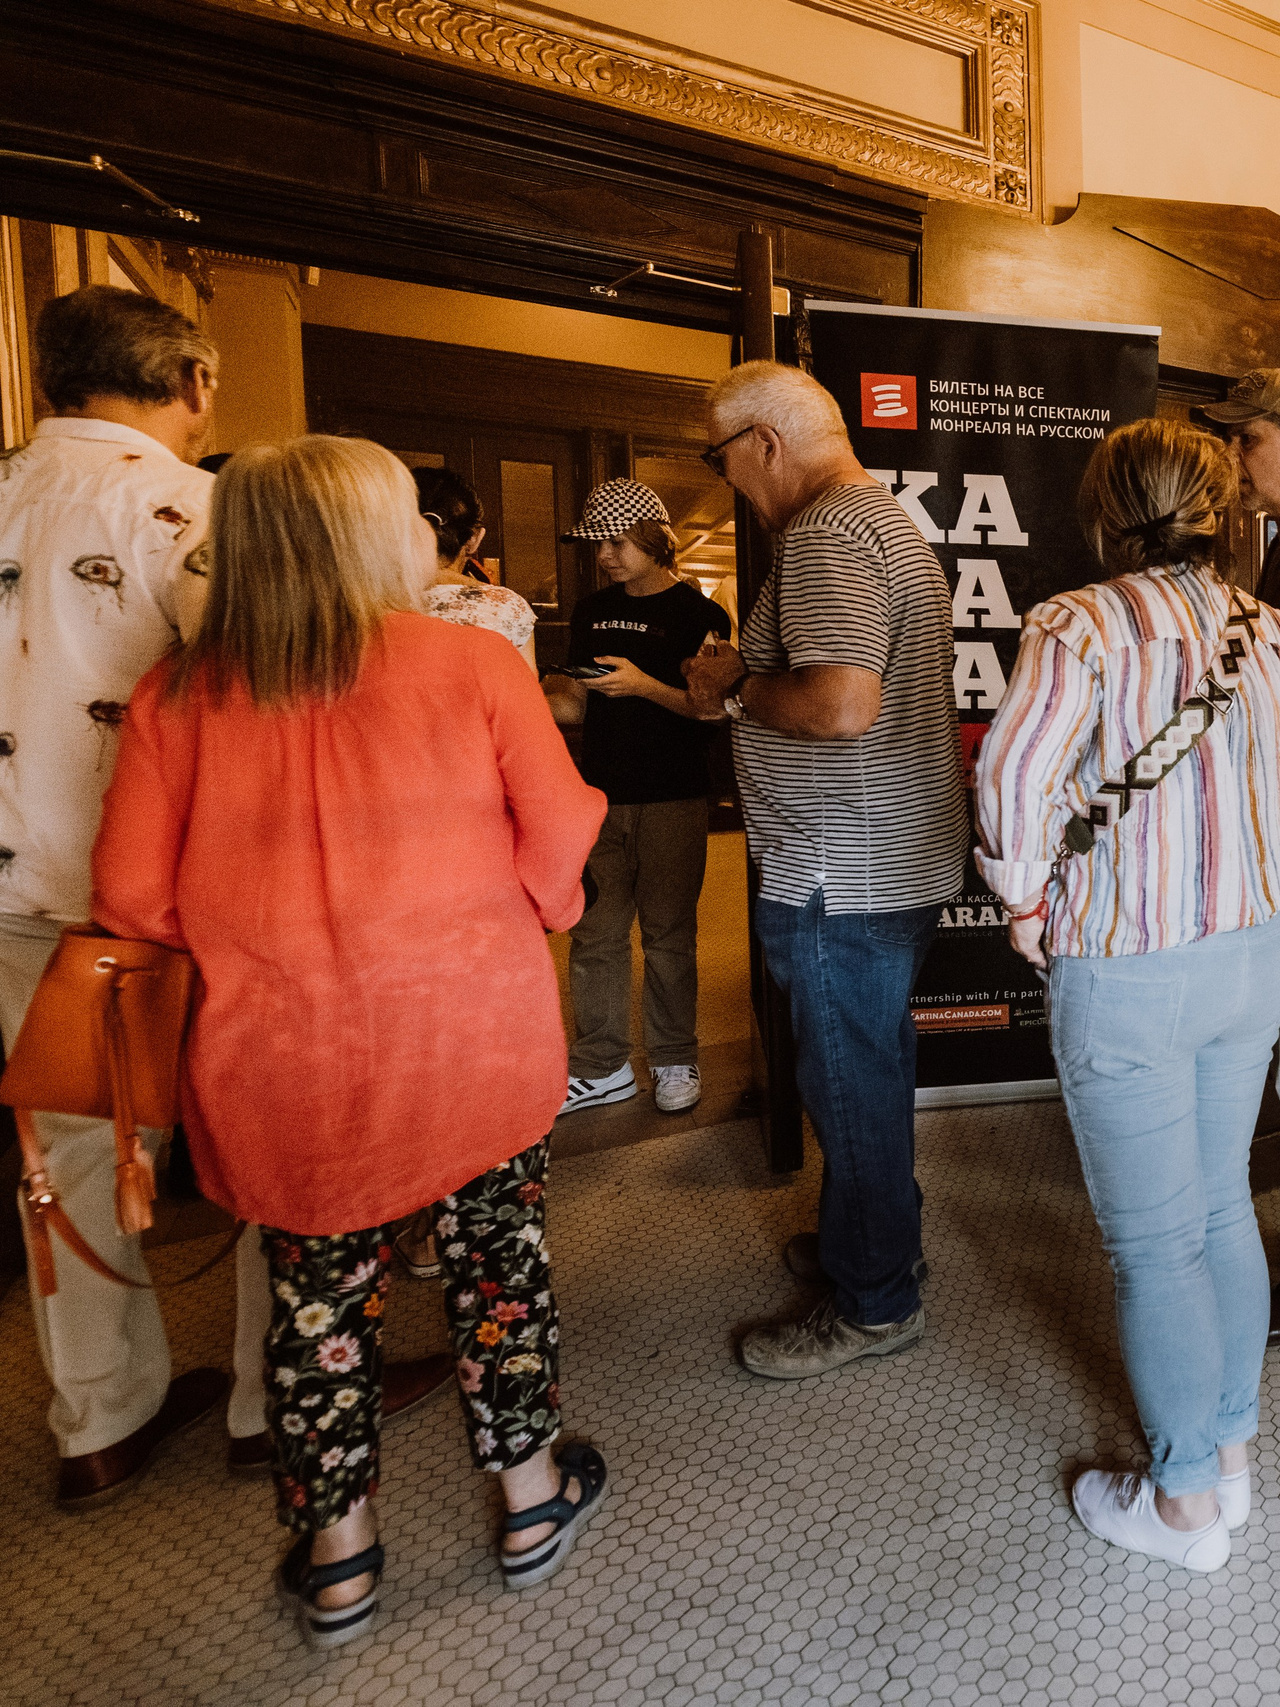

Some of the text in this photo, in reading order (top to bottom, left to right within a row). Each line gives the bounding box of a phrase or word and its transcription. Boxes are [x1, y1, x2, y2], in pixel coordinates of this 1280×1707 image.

[929, 379, 1045, 400] БИЛЕТЫ НА ВСЕ
[930, 399, 1110, 422] КОНЦЕРТЫ И СПЕКТАКЛИ
[930, 418, 1105, 440] МОНРЕАЛЯ НА РУССКОМ
[953, 558, 1022, 629] A
[953, 641, 1008, 710] A
[949, 894, 1001, 904] АЯ КАССА
[937, 905, 1010, 928] ARA
[910, 993, 962, 1003] rtnership
[966, 992, 990, 1001] with
[1004, 990, 1017, 999] En
[1021, 989, 1043, 1000] part
